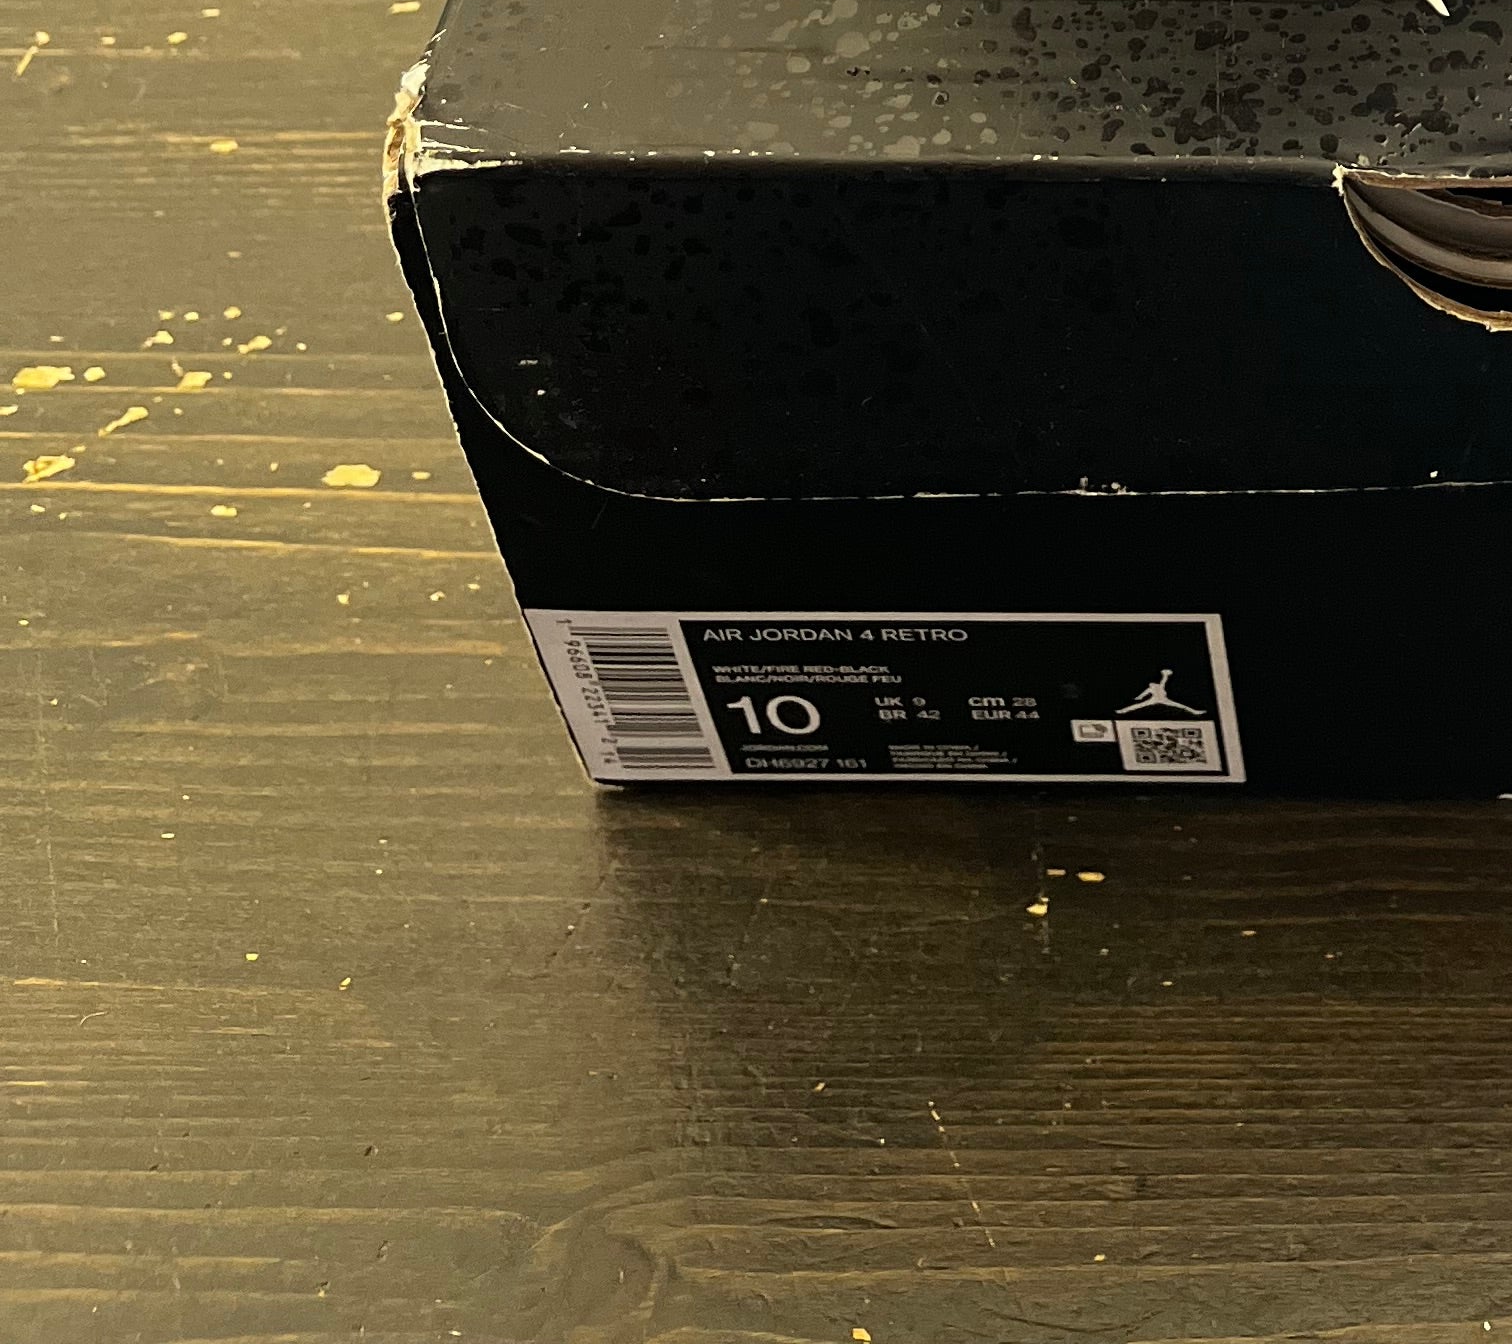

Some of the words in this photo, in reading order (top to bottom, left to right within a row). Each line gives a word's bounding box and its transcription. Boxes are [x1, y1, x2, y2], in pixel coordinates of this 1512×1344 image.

[703, 628, 744, 642] AIR
[749, 628, 852, 642] JORDAN
[859, 628, 876, 642] 4
[881, 628, 969, 642] RETRO
[874, 696, 903, 707] UK
[726, 695, 821, 736] 10
[970, 709, 1012, 721] EUR
[1013, 709, 1041, 720] 44
